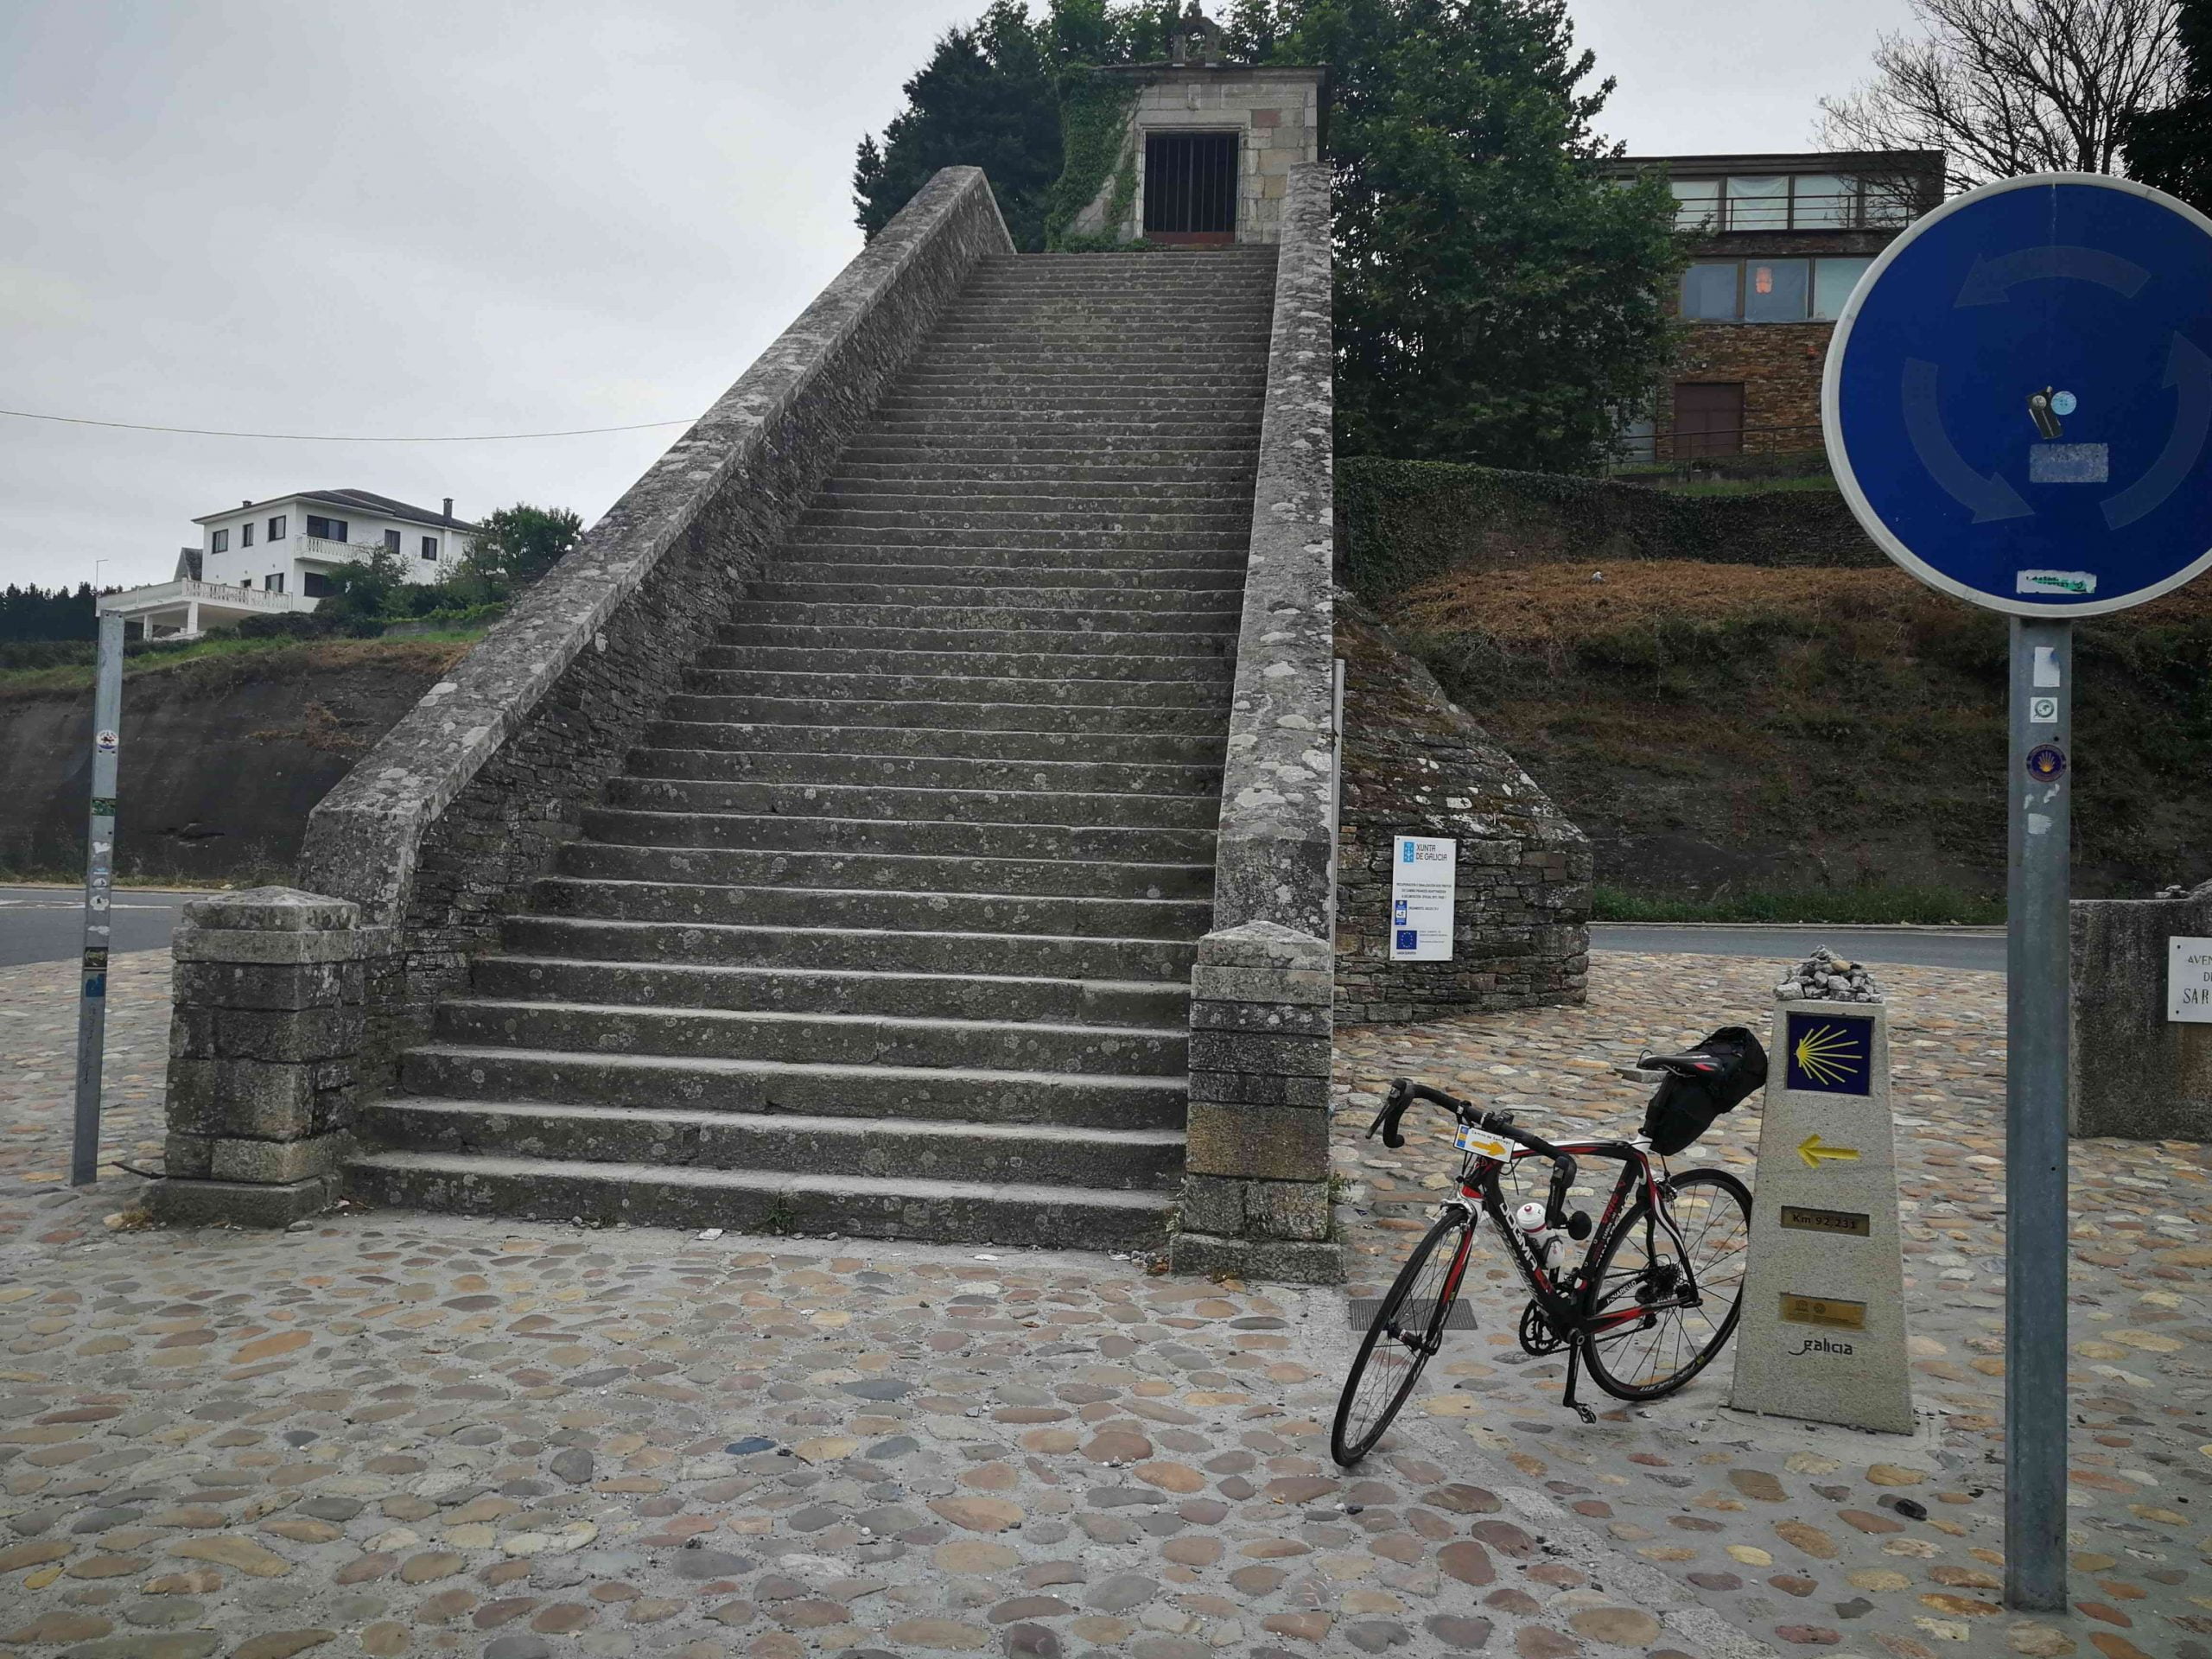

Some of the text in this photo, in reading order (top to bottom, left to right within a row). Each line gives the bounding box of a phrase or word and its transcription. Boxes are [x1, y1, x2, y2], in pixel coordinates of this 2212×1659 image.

[1416, 843, 1436, 852] XUNTA
[1792, 1213, 1811, 1224] Km
[1499, 1202, 1538, 1272] DOGMA
[1605, 1280, 1637, 1305] PINARELLO
[1788, 1338, 1853, 1356] galicia
